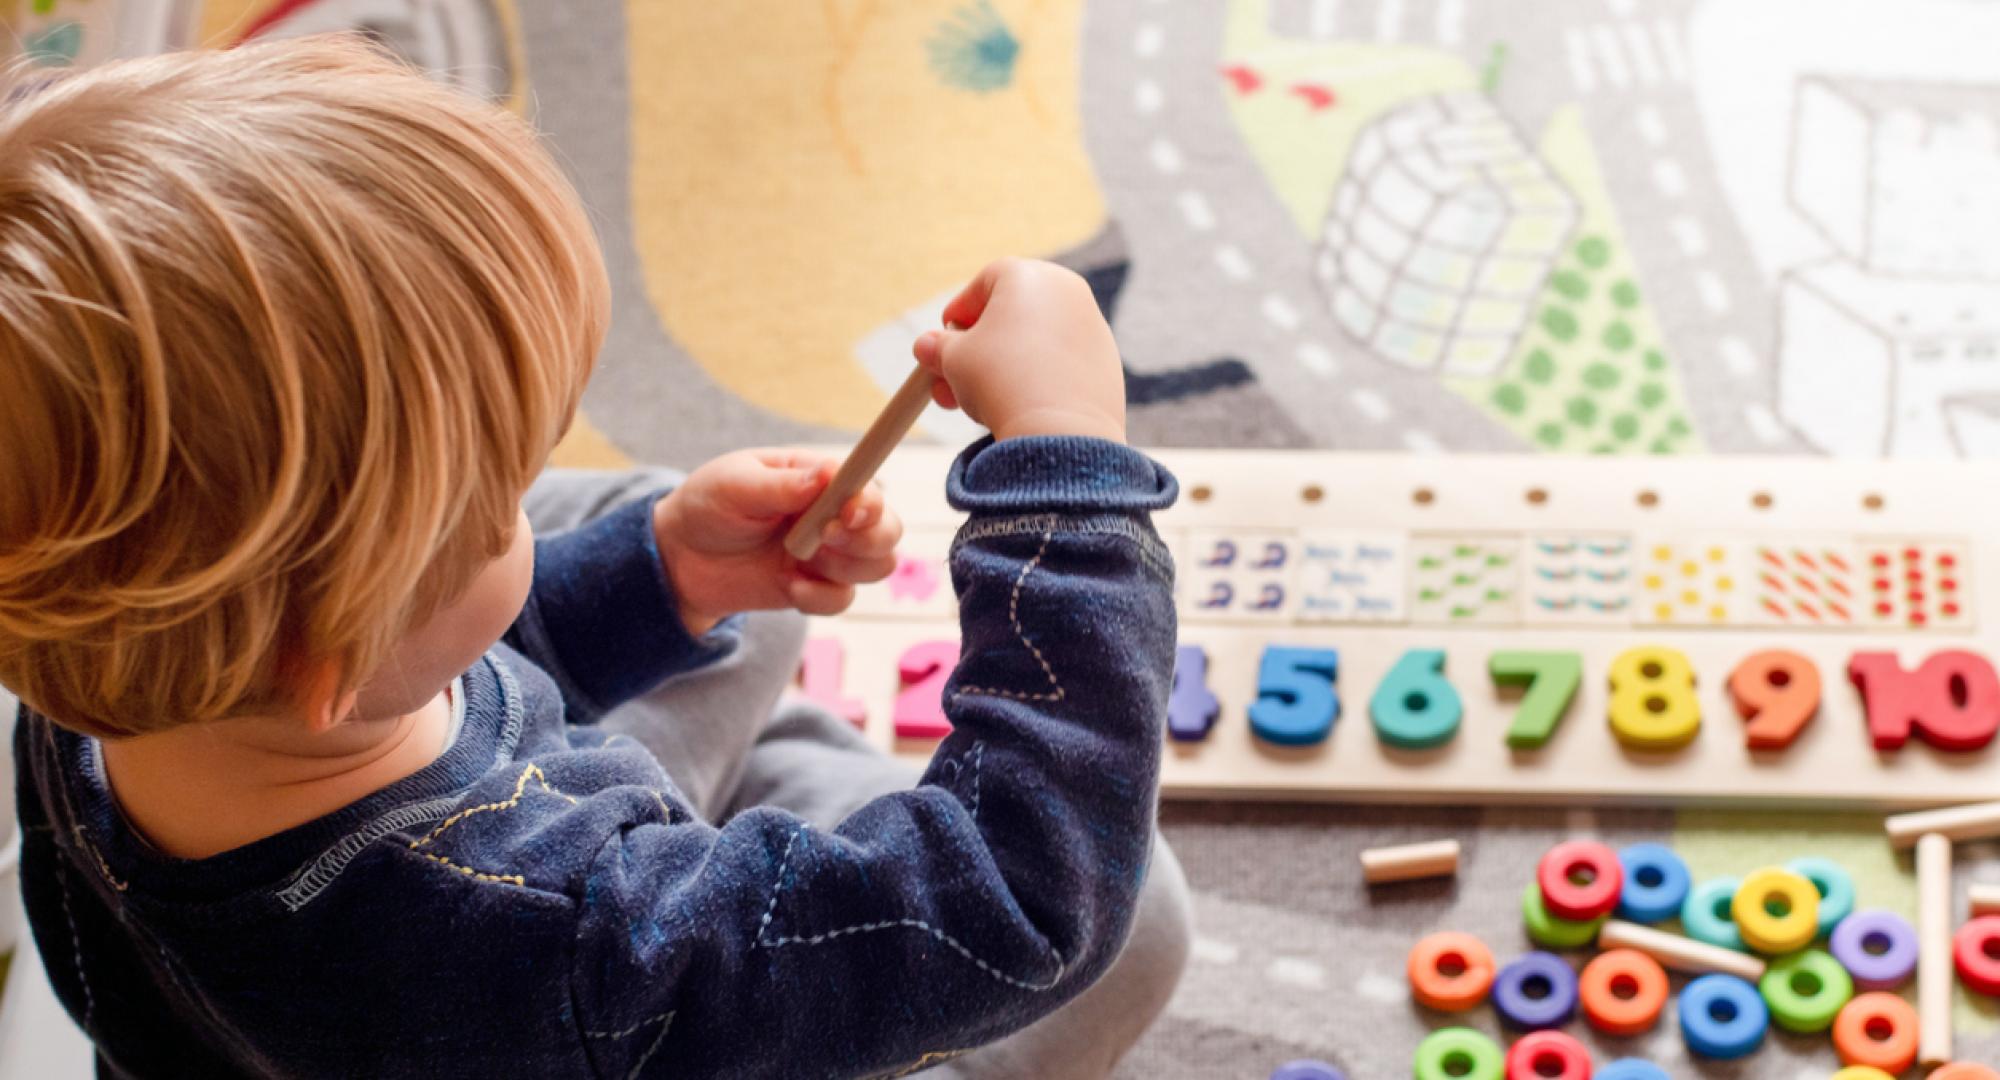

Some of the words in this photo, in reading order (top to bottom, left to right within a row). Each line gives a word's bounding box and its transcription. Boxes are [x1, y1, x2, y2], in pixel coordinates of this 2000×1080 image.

[894, 640, 961, 738] 2
[1248, 646, 1340, 746] 5
[1369, 648, 1463, 749] 6
[1488, 649, 1583, 750] 7
[1607, 645, 1701, 751] 8
[1727, 648, 1821, 751] 9
[1848, 649, 2000, 752] 10
